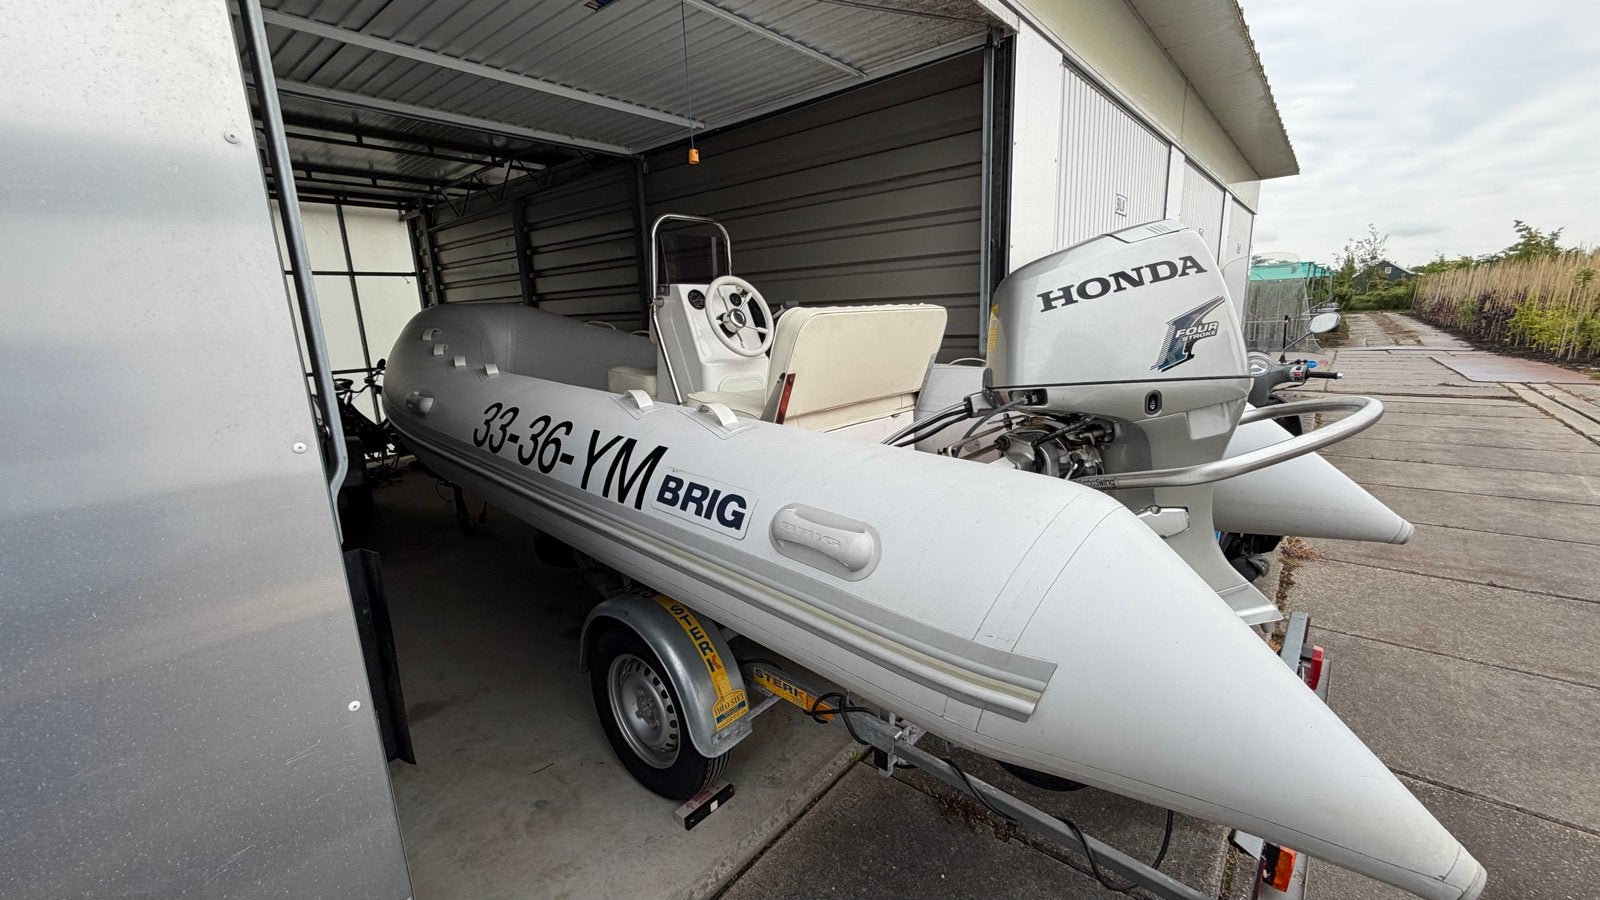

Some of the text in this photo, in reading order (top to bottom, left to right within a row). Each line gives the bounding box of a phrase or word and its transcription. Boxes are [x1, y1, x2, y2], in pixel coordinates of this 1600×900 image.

[1037, 255, 1207, 313] HONDA
[1175, 322, 1218, 339] FOUR
[1181, 329, 1216, 342] STROKE
[473, 402, 669, 510] 33-36-YM
[656, 474, 747, 531] BRIG
[670, 604, 723, 673] STERK
[755, 668, 807, 703] STERK
